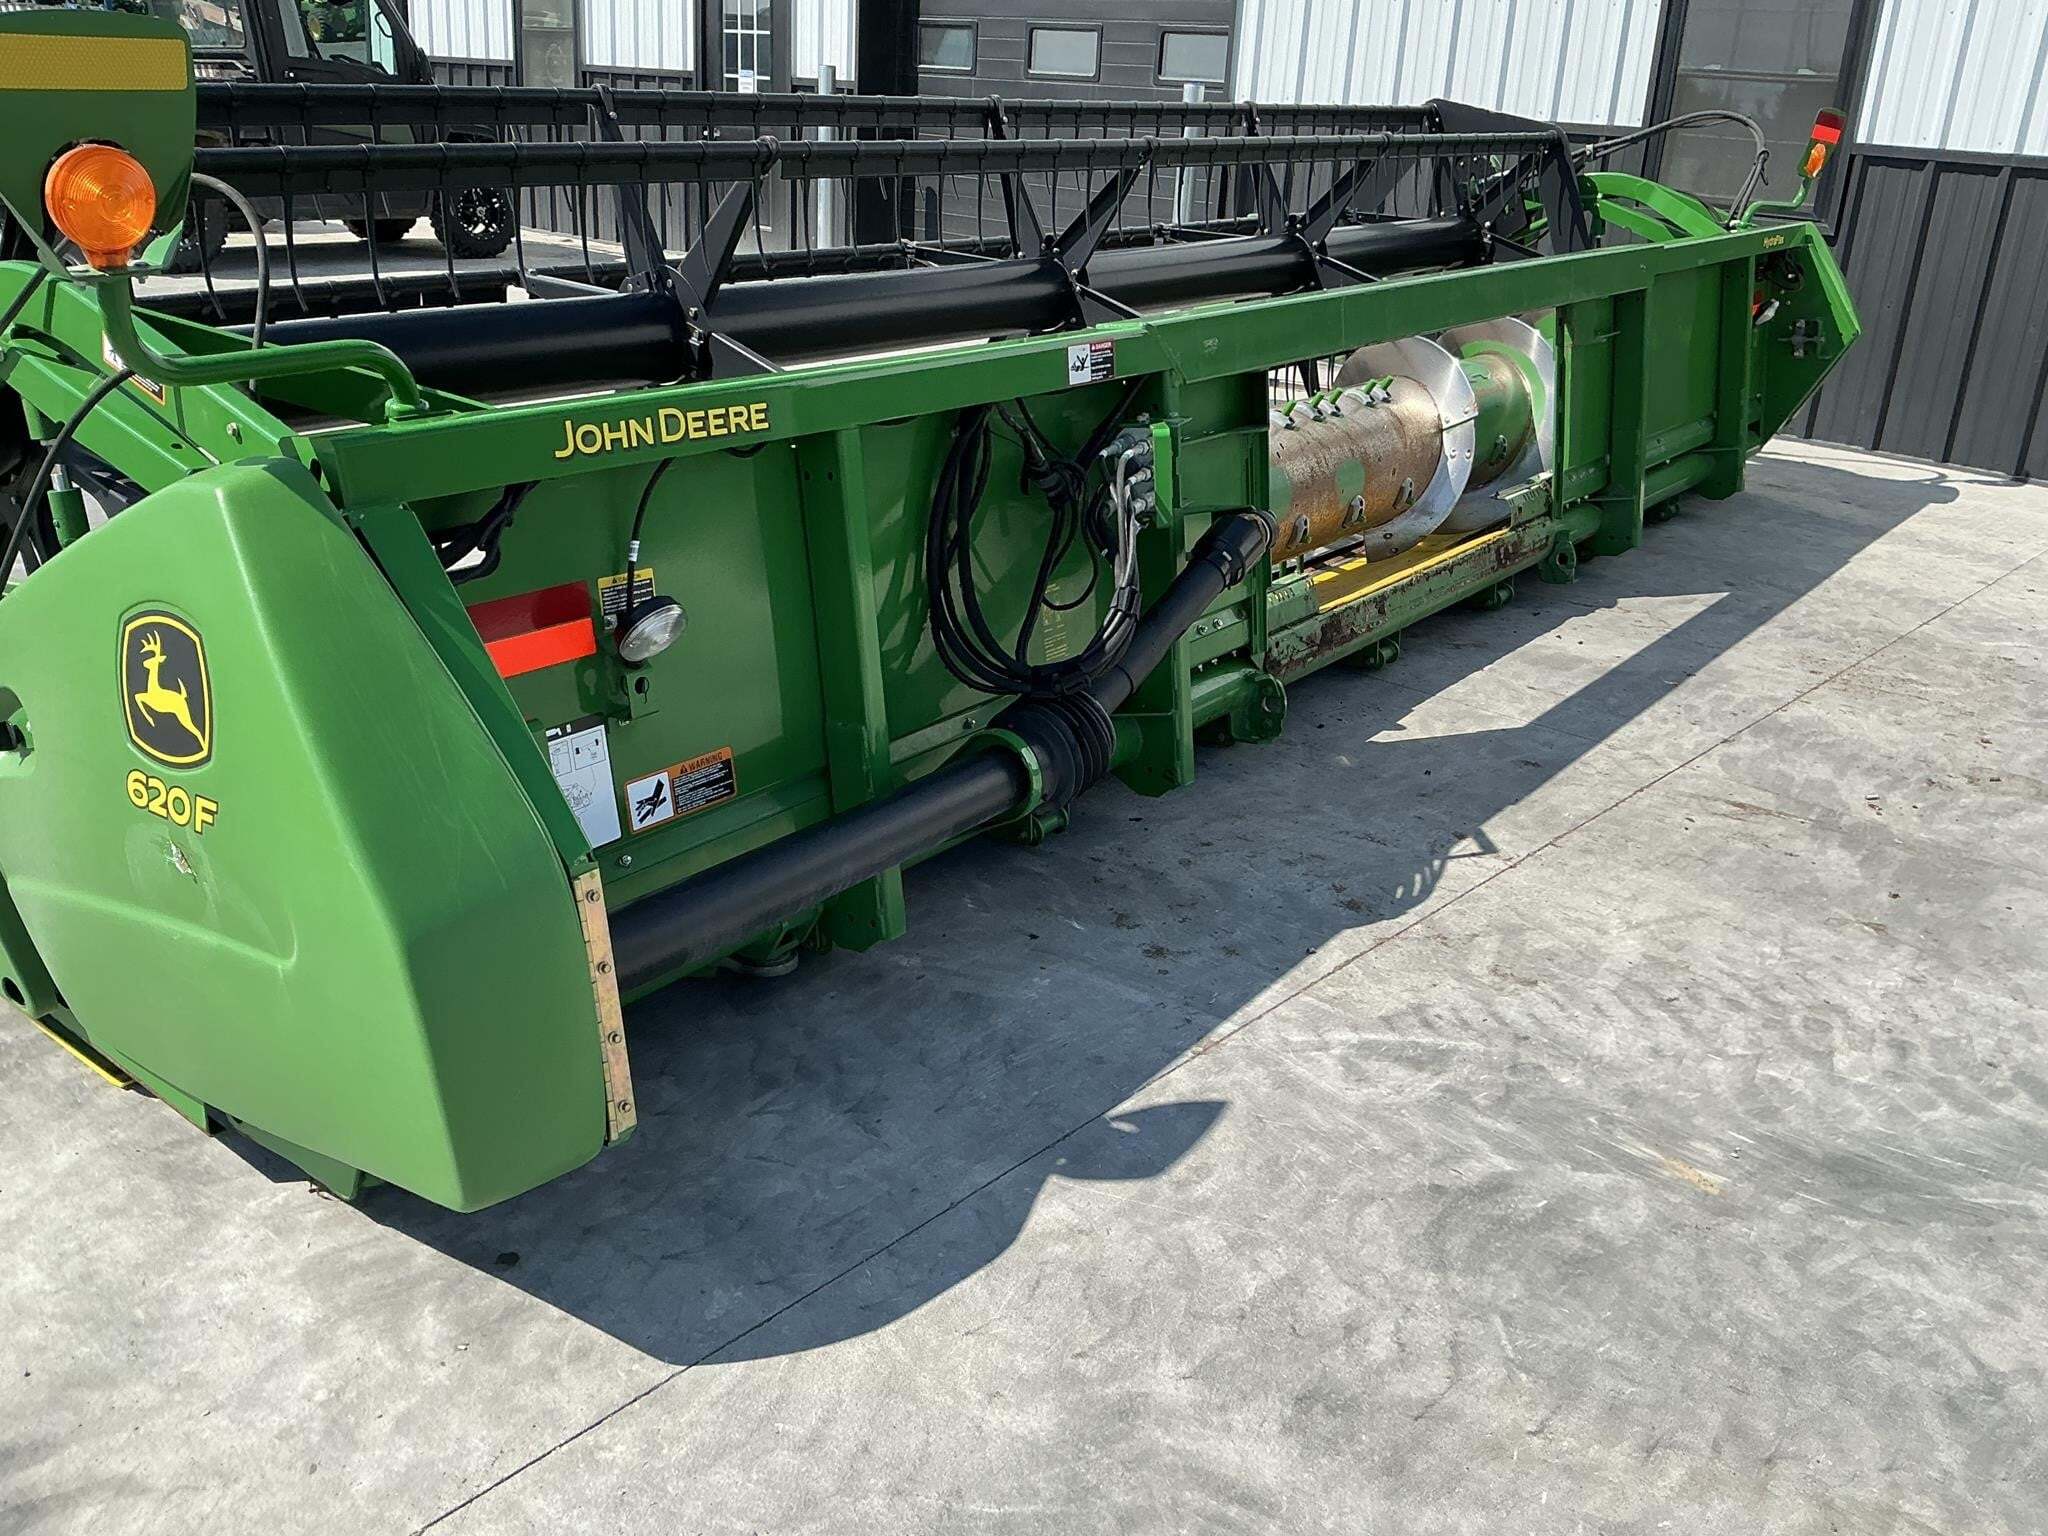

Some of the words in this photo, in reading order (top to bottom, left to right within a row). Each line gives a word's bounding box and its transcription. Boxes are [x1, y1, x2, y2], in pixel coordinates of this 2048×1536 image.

[555, 416, 655, 459] JOHN
[658, 402, 770, 443] DEERE
[688, 751, 723, 771] WARNING
